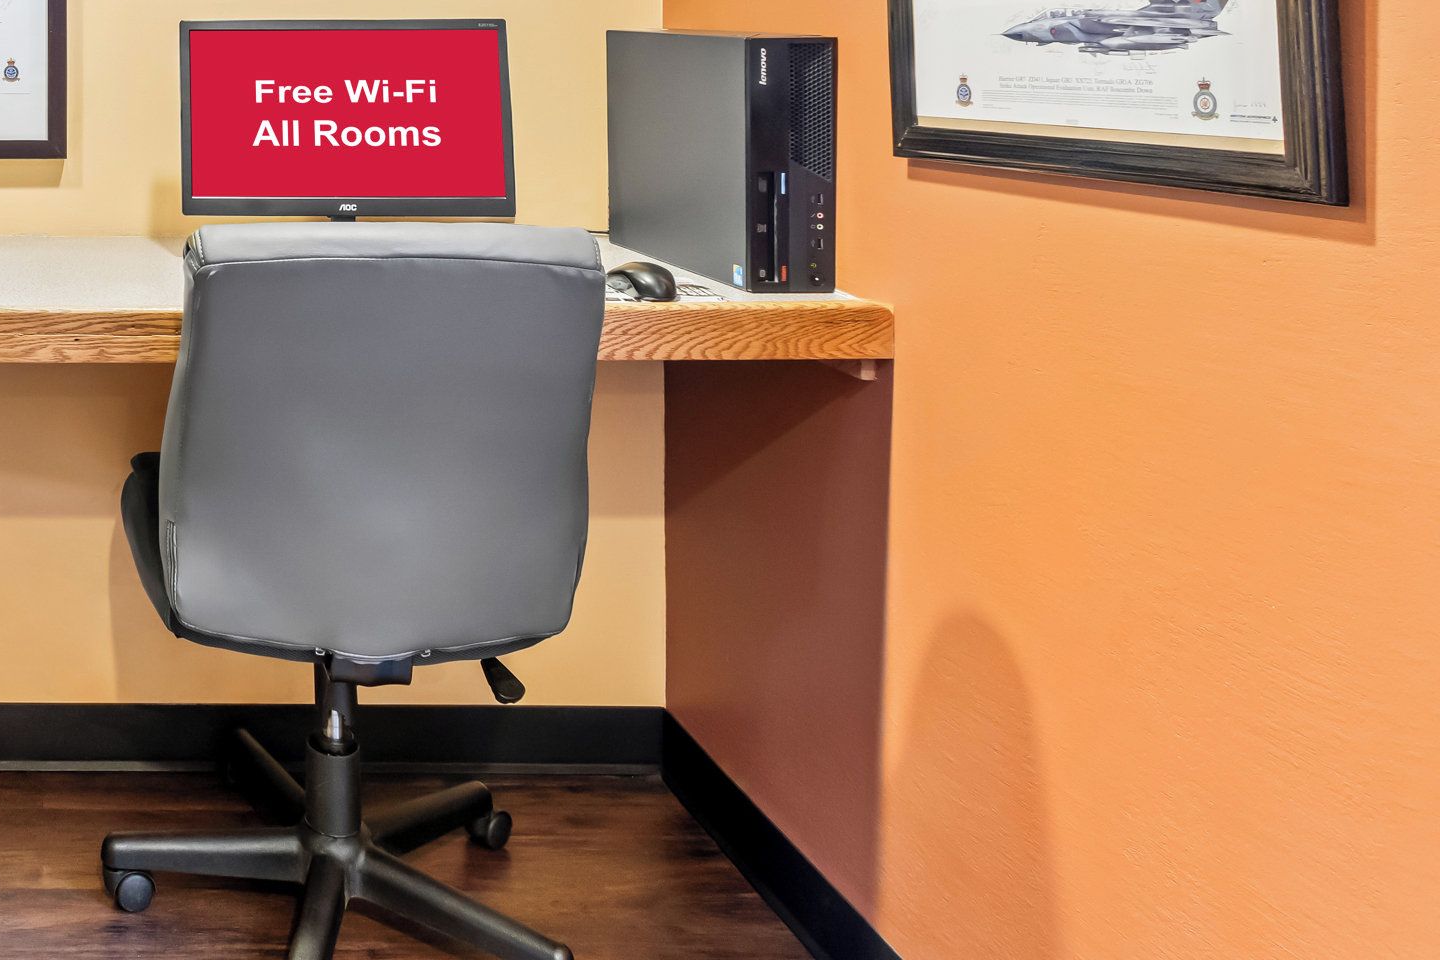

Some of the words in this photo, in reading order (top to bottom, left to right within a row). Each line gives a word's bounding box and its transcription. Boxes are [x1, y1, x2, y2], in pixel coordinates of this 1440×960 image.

[759, 47, 767, 85] lenovo
[255, 80, 333, 103] Free
[344, 80, 437, 103] Wi-Fi
[252, 120, 300, 146] All
[314, 120, 441, 147] Rooms
